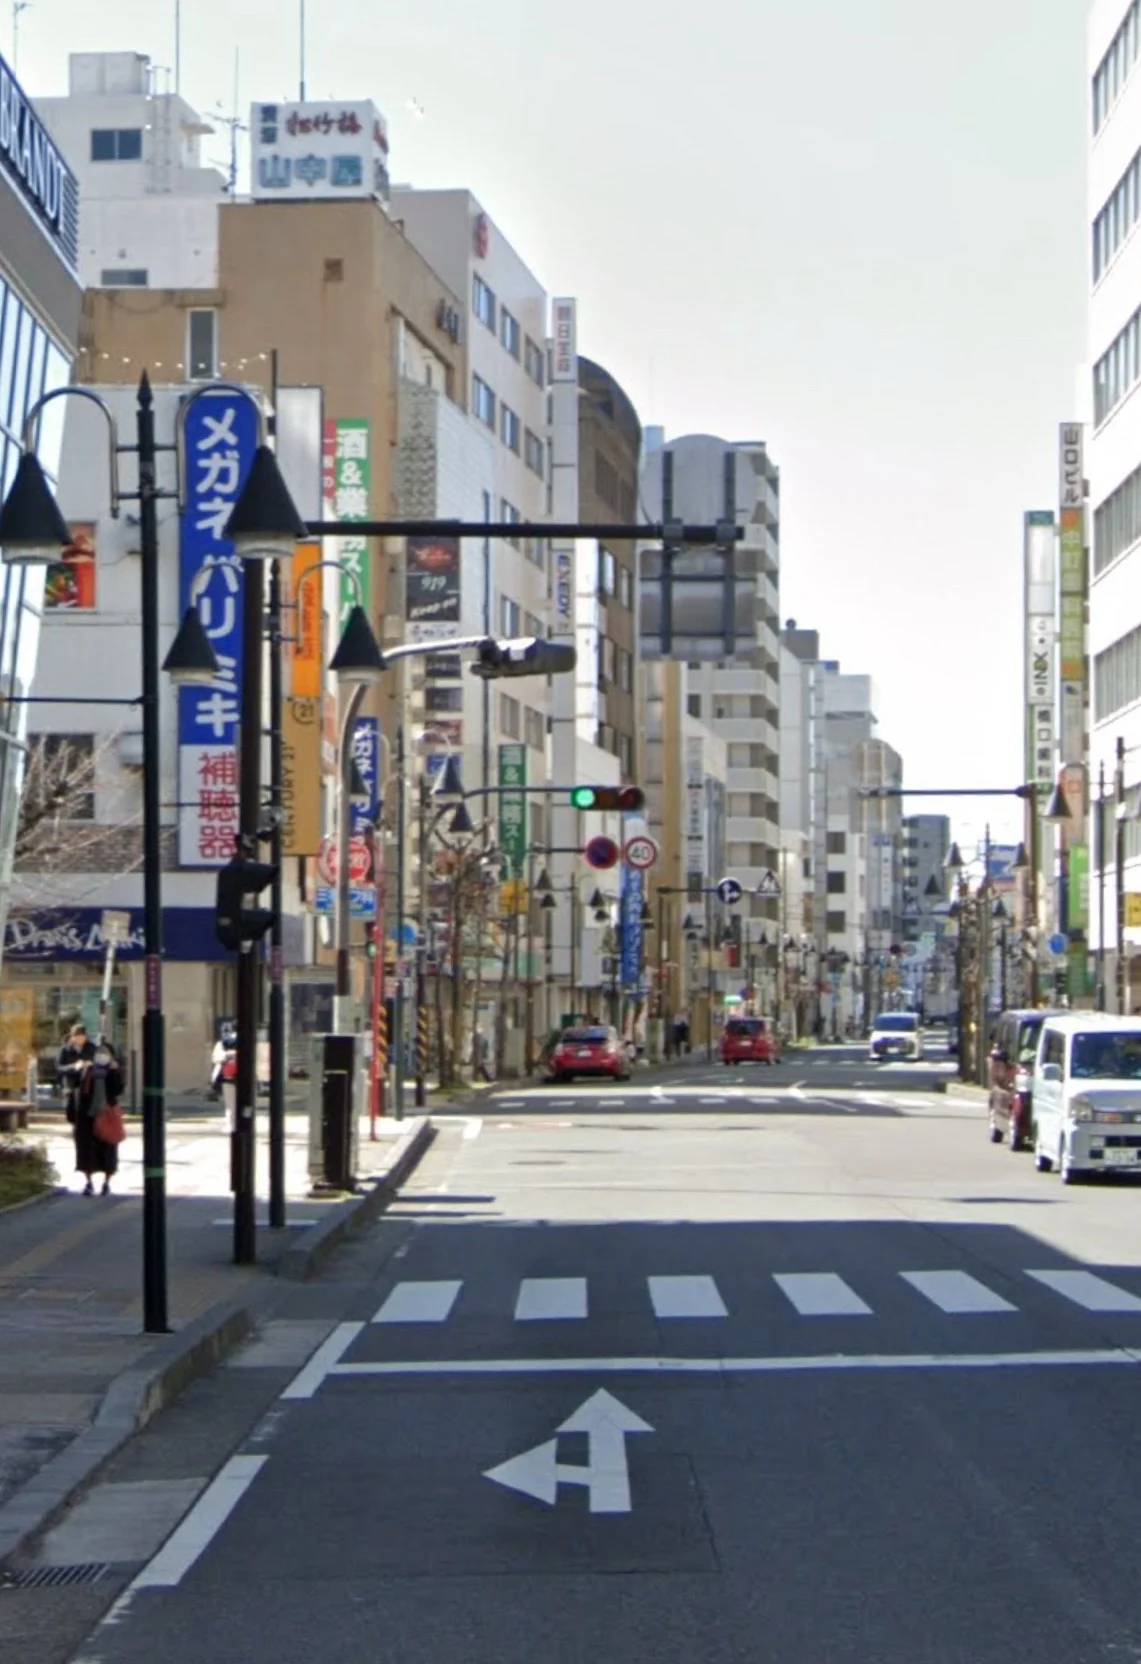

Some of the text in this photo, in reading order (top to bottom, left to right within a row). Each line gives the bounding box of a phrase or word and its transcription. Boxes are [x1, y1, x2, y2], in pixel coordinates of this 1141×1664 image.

[558, 554, 571, 619] EXEDY
[198, 751, 240, 859] 補聴器
[630, 845, 651, 860] 40
